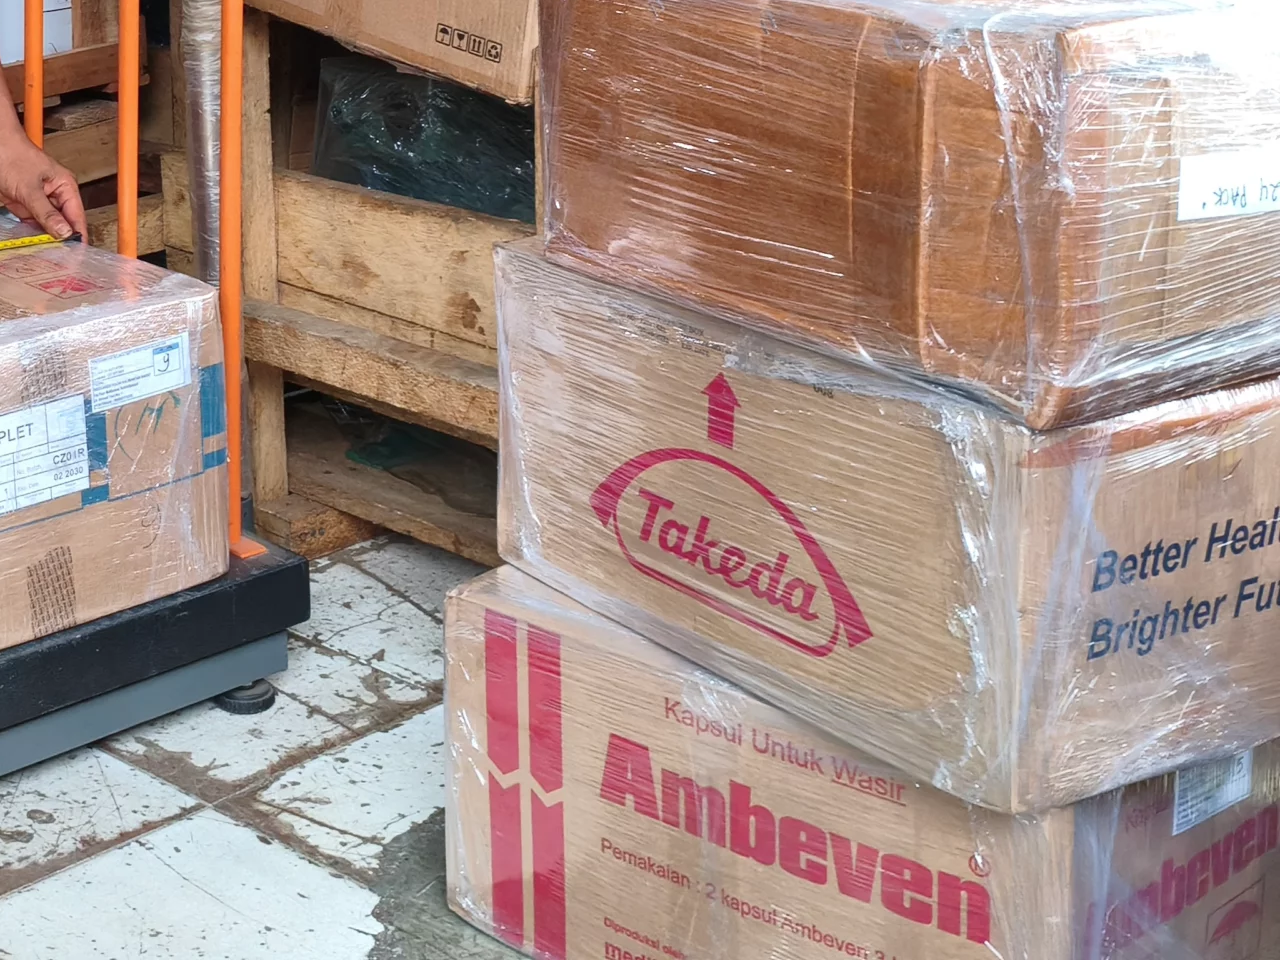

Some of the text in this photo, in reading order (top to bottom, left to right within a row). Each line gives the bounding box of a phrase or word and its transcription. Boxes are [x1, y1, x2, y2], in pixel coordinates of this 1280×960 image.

[53, 471, 63, 481] 02
[65, 466, 84, 479] 2030
[637, 487, 819, 622] Takeda
[1092, 537, 1198, 593] Better
[1087, 594, 1227, 662] Brighter
[664, 697, 906, 802] Kapsul Untuk Wasir
[600, 732, 991, 945] Ambeven
[601, 837, 692, 891] Pemakaian
[705, 882, 718, 901] 2
[721, 889, 778, 927] kapsul
[780, 910, 869, 959] Ambeven
[604, 916, 660, 952] Diproduksi
